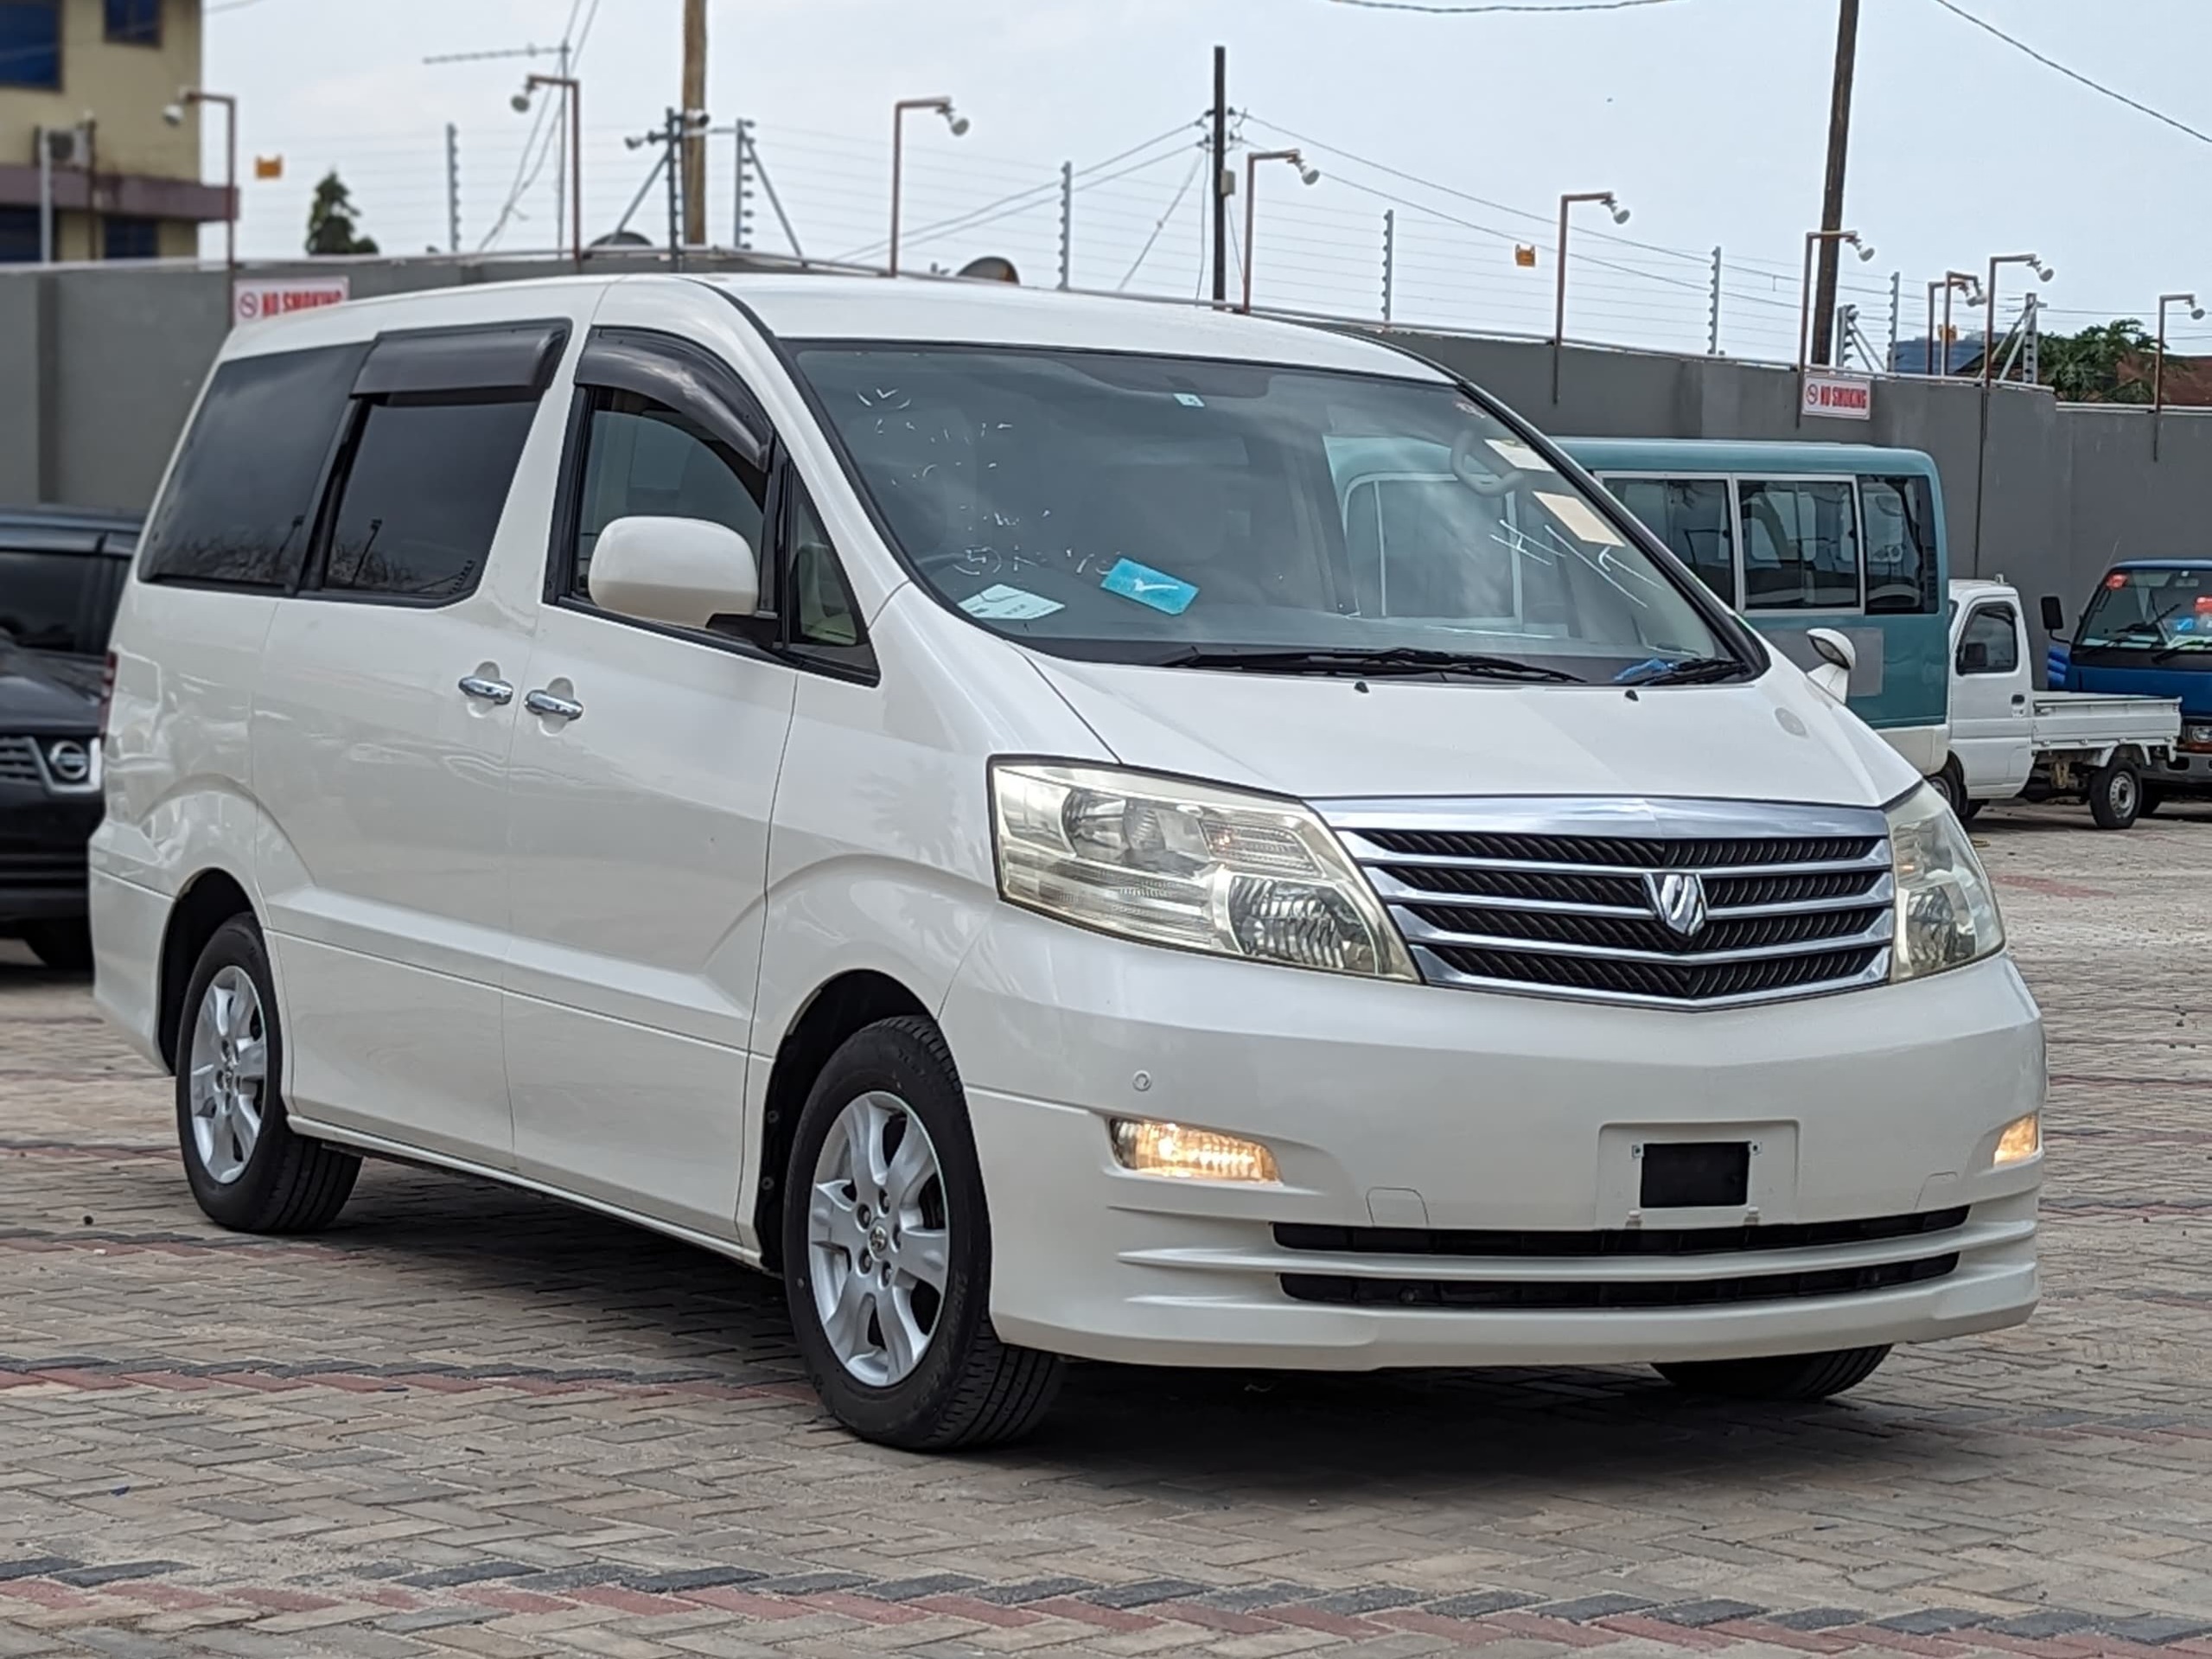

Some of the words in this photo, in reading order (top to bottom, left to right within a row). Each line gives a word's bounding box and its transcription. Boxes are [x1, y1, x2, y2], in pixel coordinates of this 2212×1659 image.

[262, 292, 278, 317] NO
[1820, 386, 1831, 406] NO
[1832, 386, 1867, 409] SMOKING
